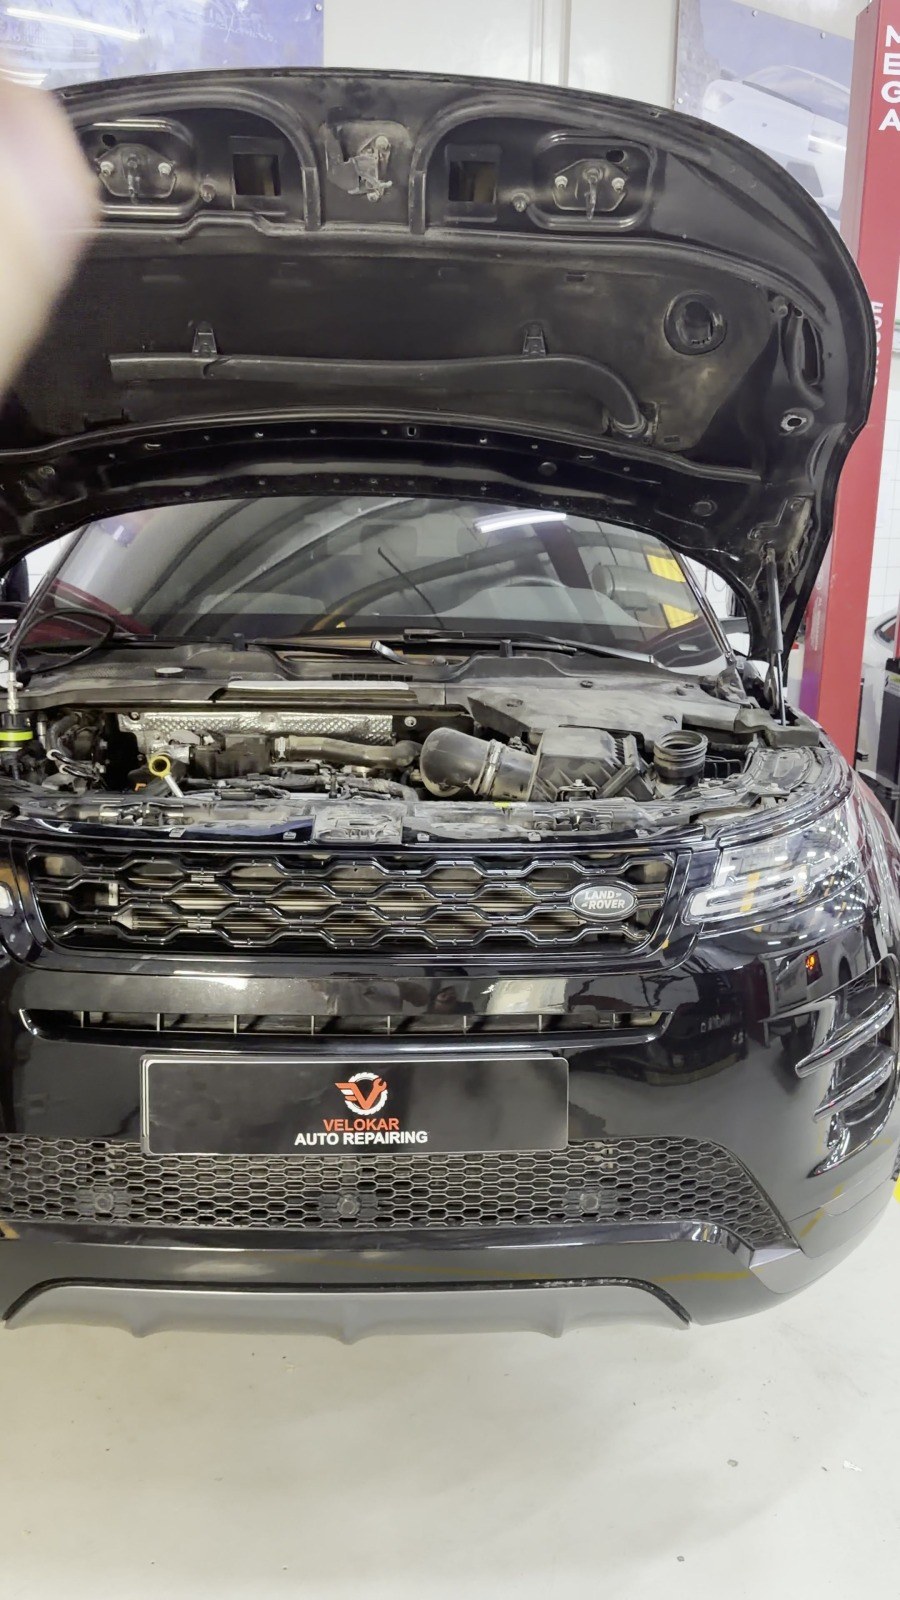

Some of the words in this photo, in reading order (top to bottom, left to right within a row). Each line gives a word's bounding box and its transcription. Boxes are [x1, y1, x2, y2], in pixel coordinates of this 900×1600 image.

[584, 890, 615, 900] LAND
[588, 899, 625, 910] ROVER
[323, 1118, 399, 1132] VELOKAR
[294, 1132, 339, 1146] AUTO
[343, 1130, 428, 1145] REPAIRING
